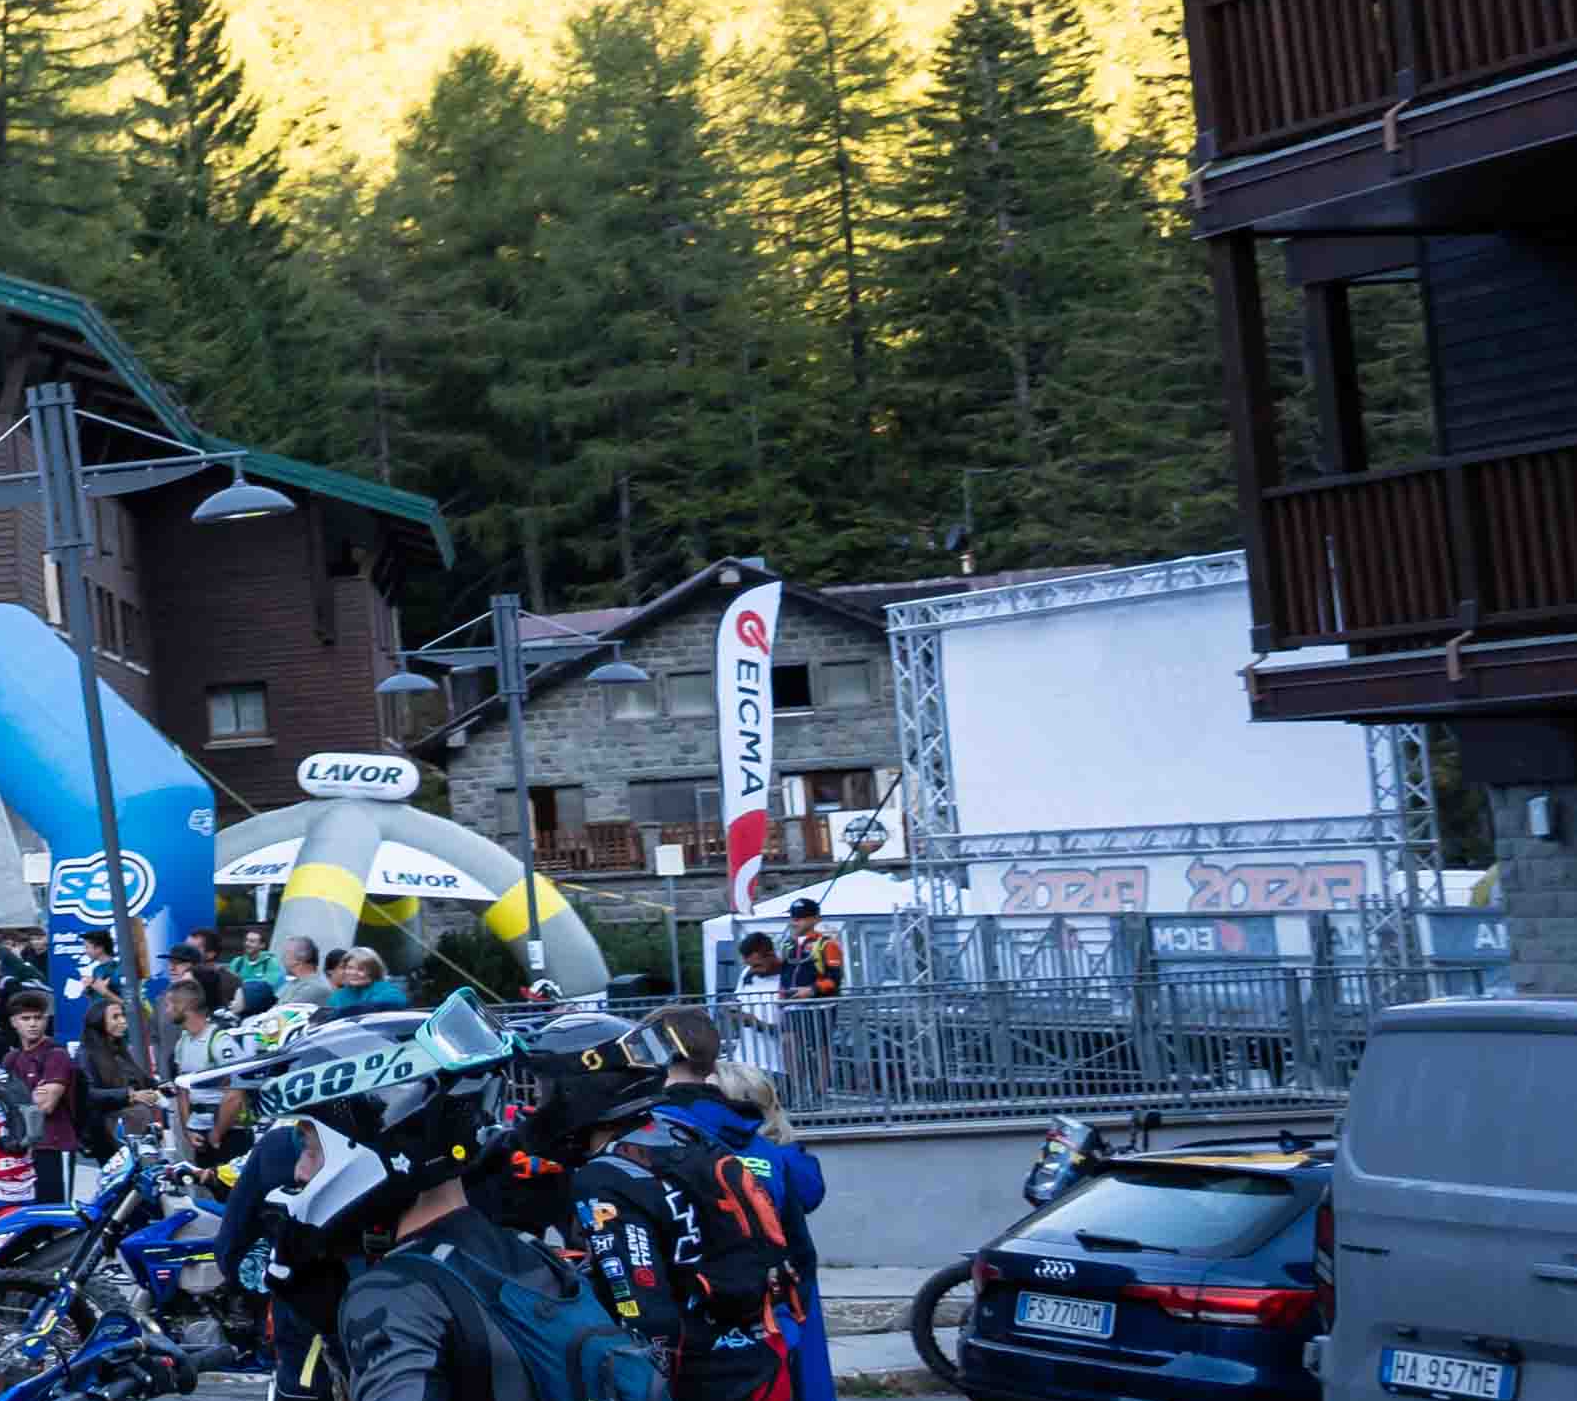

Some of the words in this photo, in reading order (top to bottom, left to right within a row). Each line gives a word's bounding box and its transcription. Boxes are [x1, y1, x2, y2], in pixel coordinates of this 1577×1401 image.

[735, 657, 765, 798] EICMA
[305, 762, 404, 786] LAVOR
[382, 870, 461, 890] LAVOR
[1027, 1297, 1047, 1321] FS
[1395, 1354, 1420, 1385] HA
[1427, 1357, 1499, 1399] 957ME
